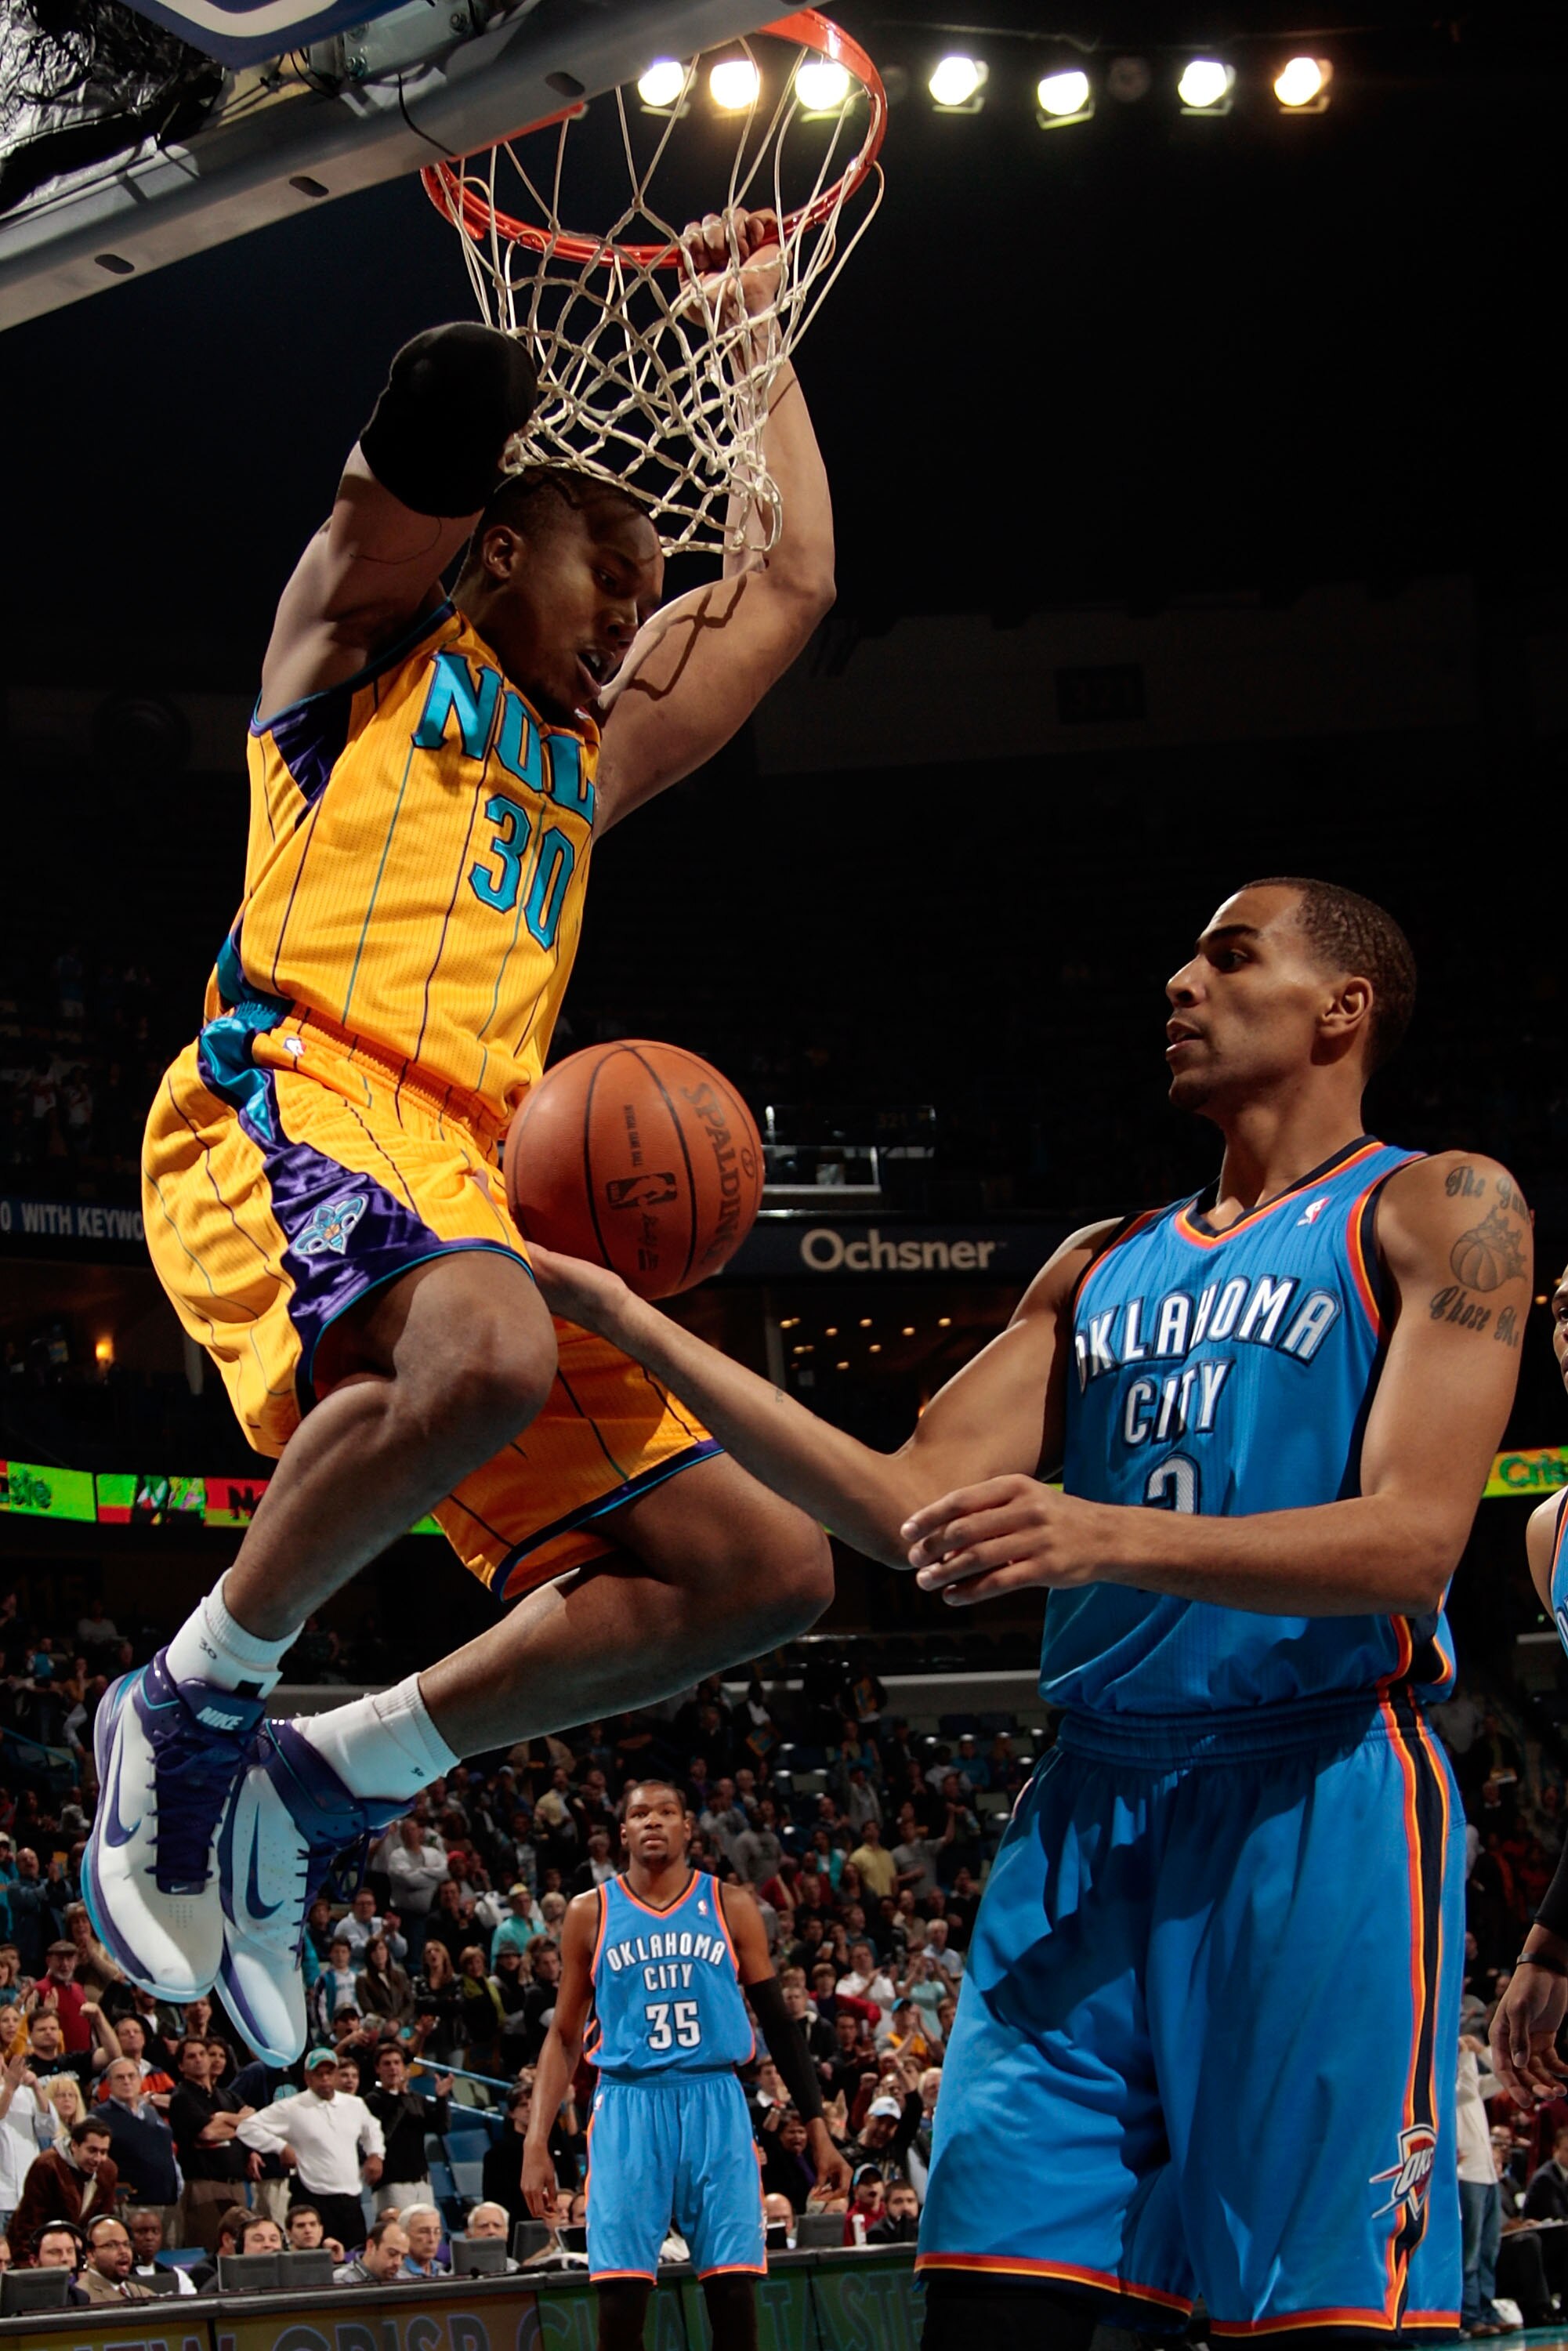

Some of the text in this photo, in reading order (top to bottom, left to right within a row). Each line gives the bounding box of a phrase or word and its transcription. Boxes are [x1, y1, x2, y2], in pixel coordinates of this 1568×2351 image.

[468, 793, 575, 952] 30
[20, 1202, 73, 1236] WITH
[800, 1228, 997, 1271] Ochsner
[1122, 1358, 1237, 1448] CITY
[200, 1637, 217, 1660] 30
[196, 1705, 244, 1730] NIKE
[606, 1932, 726, 1972] OKLAHOMA
[643, 1962, 693, 1991] CITY
[645, 2000, 701, 2051] 35
